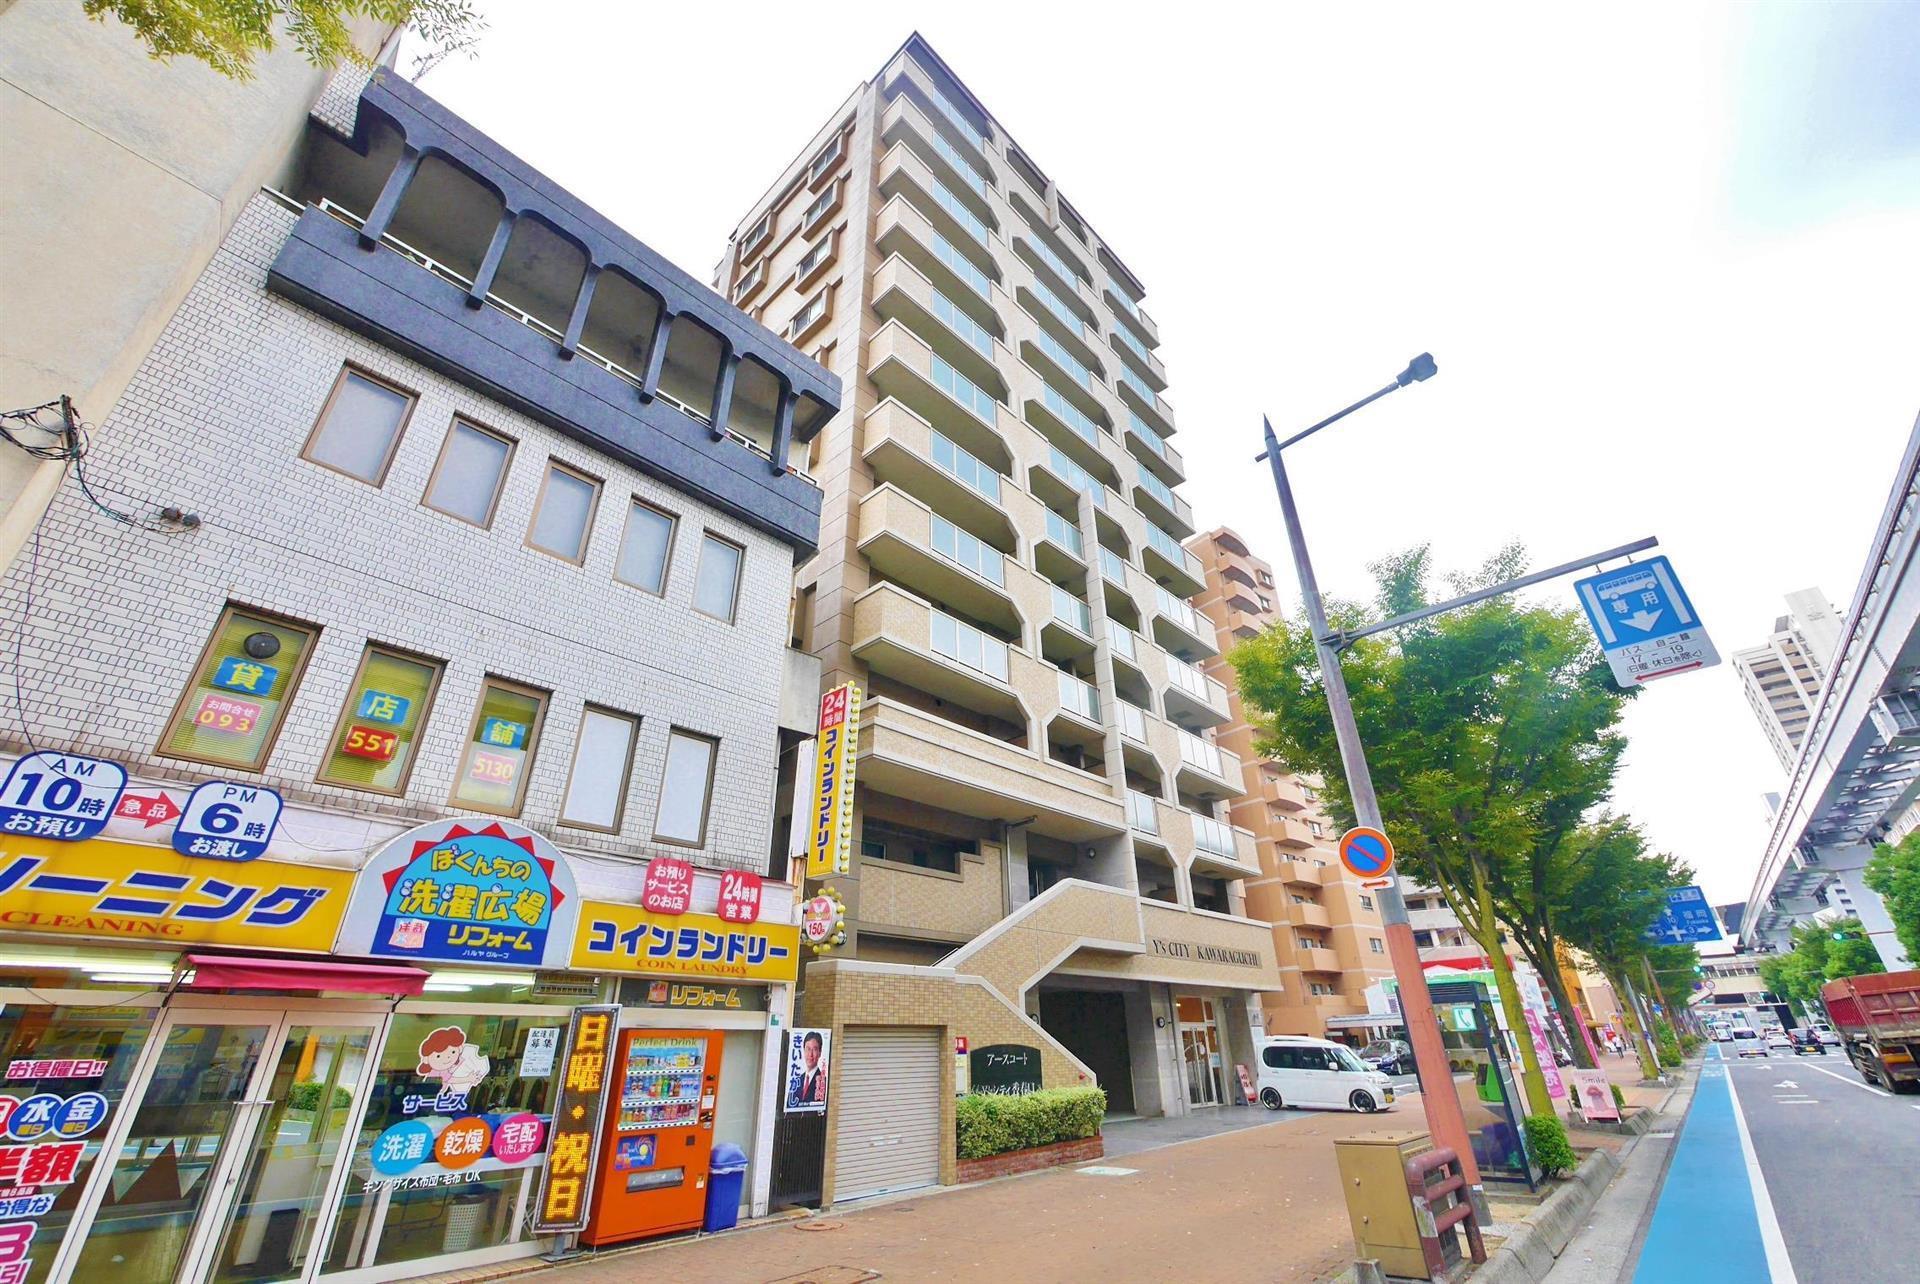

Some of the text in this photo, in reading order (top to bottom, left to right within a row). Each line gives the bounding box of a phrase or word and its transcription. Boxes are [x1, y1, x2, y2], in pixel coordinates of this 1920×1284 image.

[207, 700, 257, 717] お問合せ
[225, 662, 517, 745] 貸 店 舗
[823, 689, 845, 715] 24
[200, 710, 513, 780] 093 551 5130
[51, 758, 96, 776] AM
[223, 786, 257, 803] PM
[816, 728, 838, 862] コインランドリー
[121, 799, 168, 819] 急品
[4, 812, 86, 837] お預り
[189, 837, 248, 858] お渡し
[431, 846, 532, 881] ぼくんちの
[654, 864, 687, 880] お預り
[647, 878, 690, 896] サービス
[723, 873, 759, 904] 24時間
[398, 878, 548, 926] 洗濯広場
[648, 892, 685, 911] のお店
[725, 903, 753, 920] 営業
[0, 910, 184, 936] CLEANING
[447, 924, 534, 951] リフォーム
[589, 920, 789, 965] コインランドリー
[1169, 942, 1190, 958] CITY
[1197, 946, 1259, 967] KAWARAGUCHI
[636, 959, 750, 976] COIN LAUNDRY
[670, 984, 741, 1007] リフォーム
[633, 1037, 698, 1047] Perfect Drink
[987, 1052, 1028, 1067] アースコート
[20, 1099, 53, 1123] 水
[66, 1097, 99, 1121] 金
[403, 1091, 469, 1114] サービス
[379, 1121, 538, 1162] 洗濯 乾燥 宅配
[499, 1143, 534, 1156] いたします
[465, 1170, 481, 1182] OK
